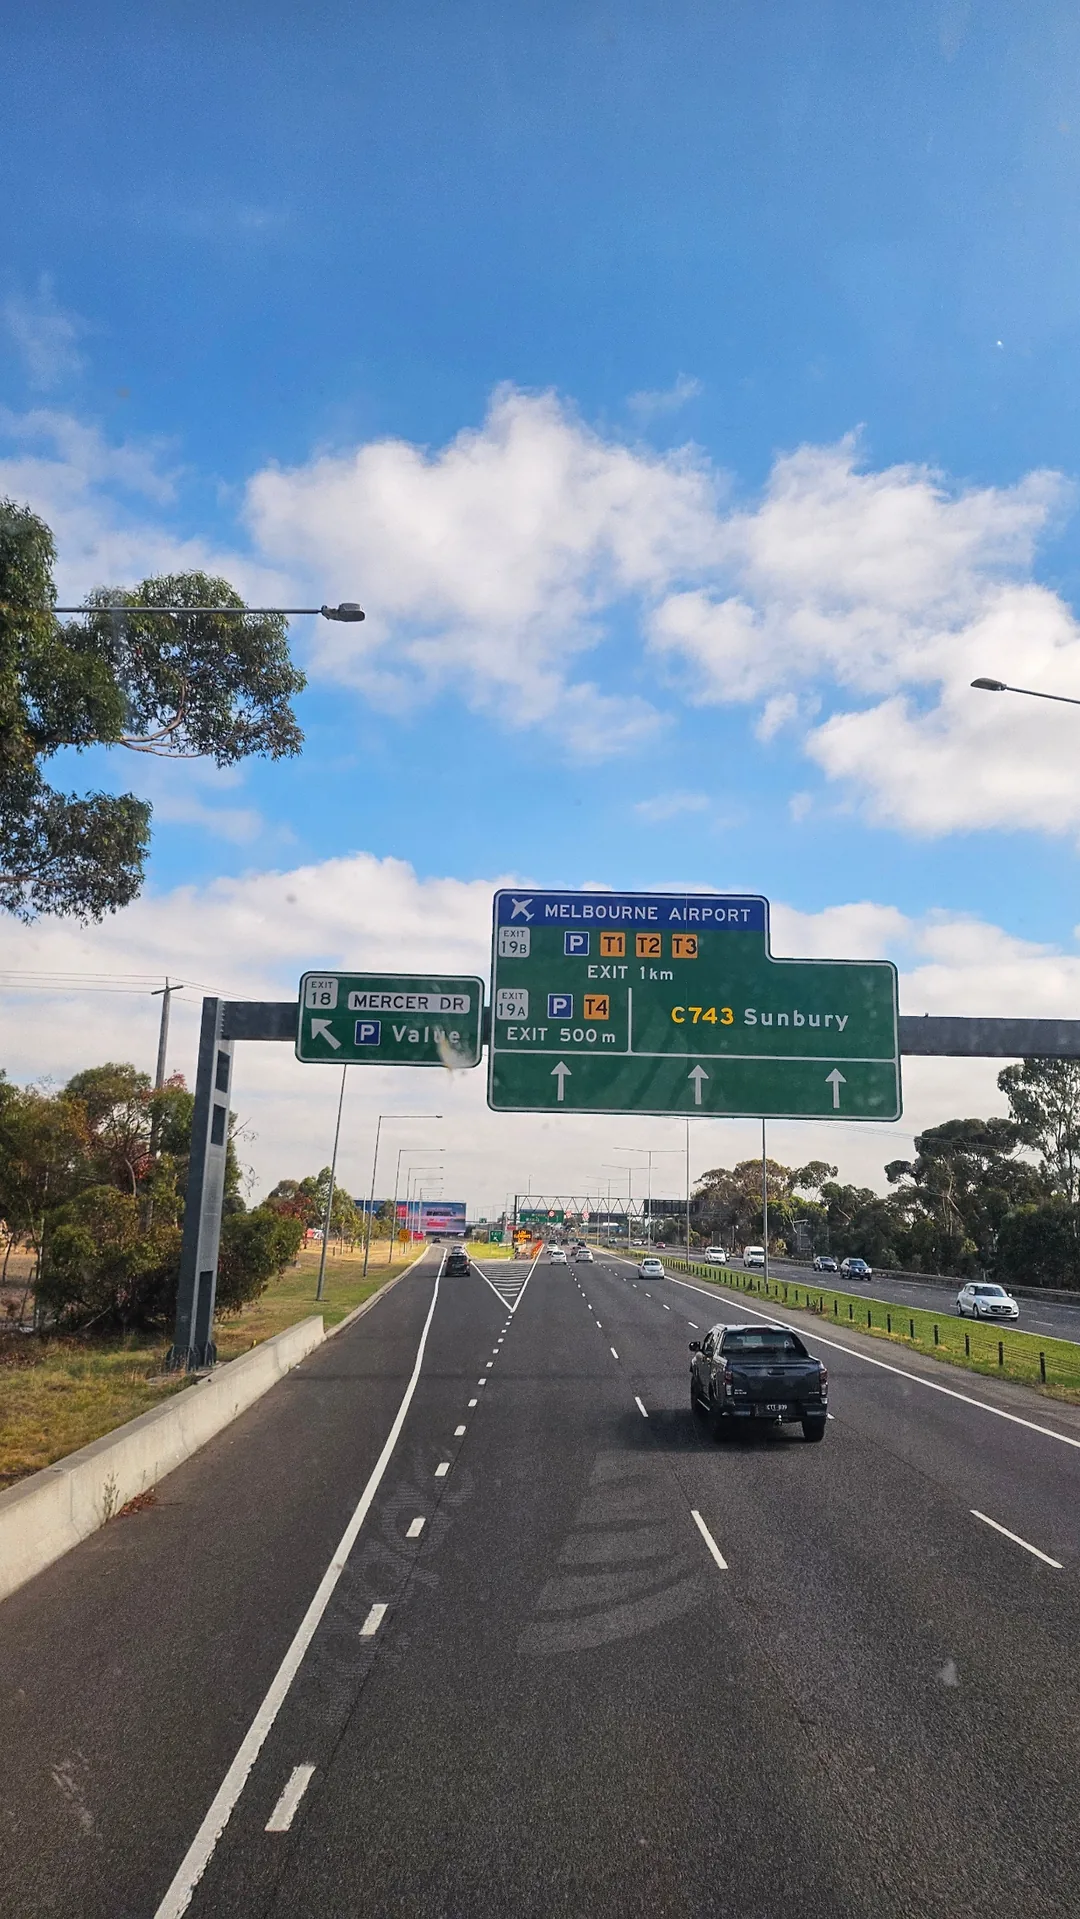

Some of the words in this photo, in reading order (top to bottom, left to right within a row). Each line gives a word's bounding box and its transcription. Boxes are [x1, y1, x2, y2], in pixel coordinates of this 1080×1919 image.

[545, 904, 658, 921] MELBOURNE
[668, 907, 751, 923] AIRPORT
[503, 930, 526, 939] EXIT
[500, 940, 527, 954] 19B
[603, 936, 624, 953] T1
[636, 937, 660, 954] T2
[672, 938, 697, 955] T3
[587, 965, 628, 980] EXIT
[311, 981, 333, 989] EXIT
[312, 992, 332, 1006] 18
[353, 994, 429, 1010] MERCER
[440, 997, 464, 1011] DR
[502, 992, 524, 1000] EXIT
[498, 1003, 526, 1017] 19A
[585, 998, 608, 1016] T4
[671, 1006, 735, 1025] C743
[744, 1008, 849, 1032] Sunbury
[391, 1025, 461, 1044] Value
[507, 1027, 549, 1041] EXIT
[560, 1028, 597, 1042] 500
